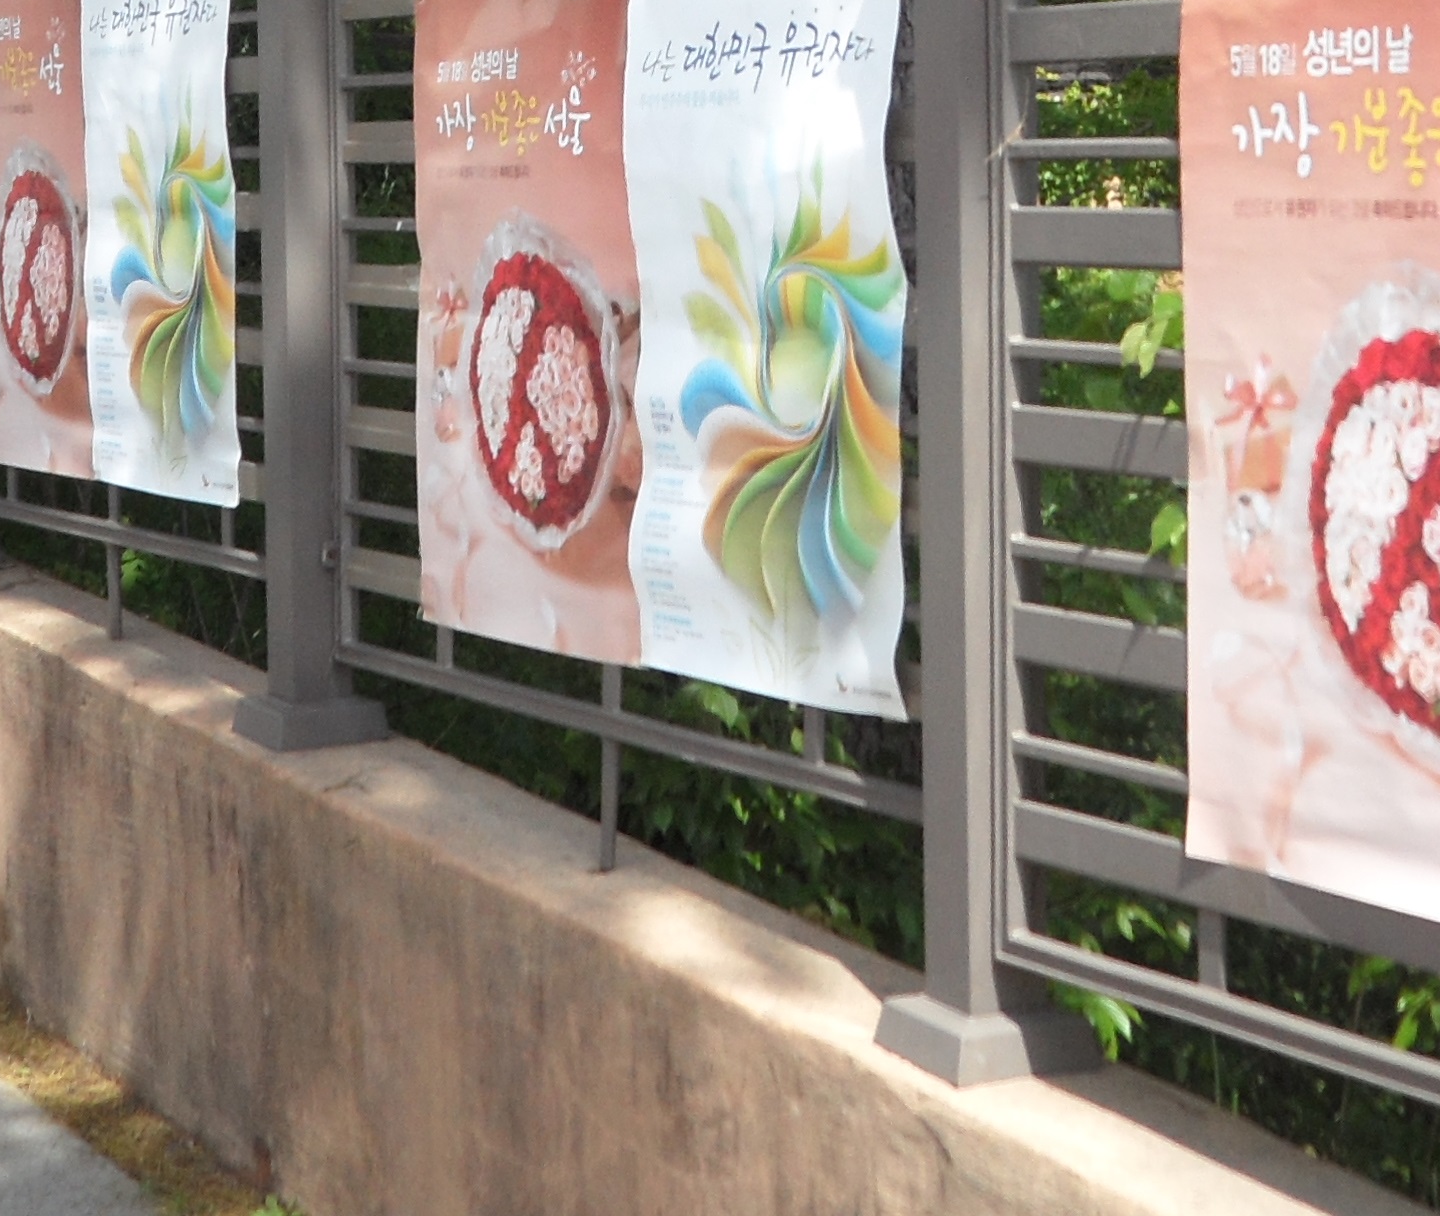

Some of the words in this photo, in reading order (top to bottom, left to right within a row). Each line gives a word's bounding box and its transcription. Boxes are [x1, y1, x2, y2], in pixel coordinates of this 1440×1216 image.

[642, 40, 676, 82] 나는
[683, 21, 771, 93] 대한민국
[779, 21, 875, 86] 유권자다
[1302, 24, 1379, 77] 성년의
[1386, 23, 1413, 74] 날
[436, 93, 476, 151] 가장
[1232, 91, 1320, 178] 가장
